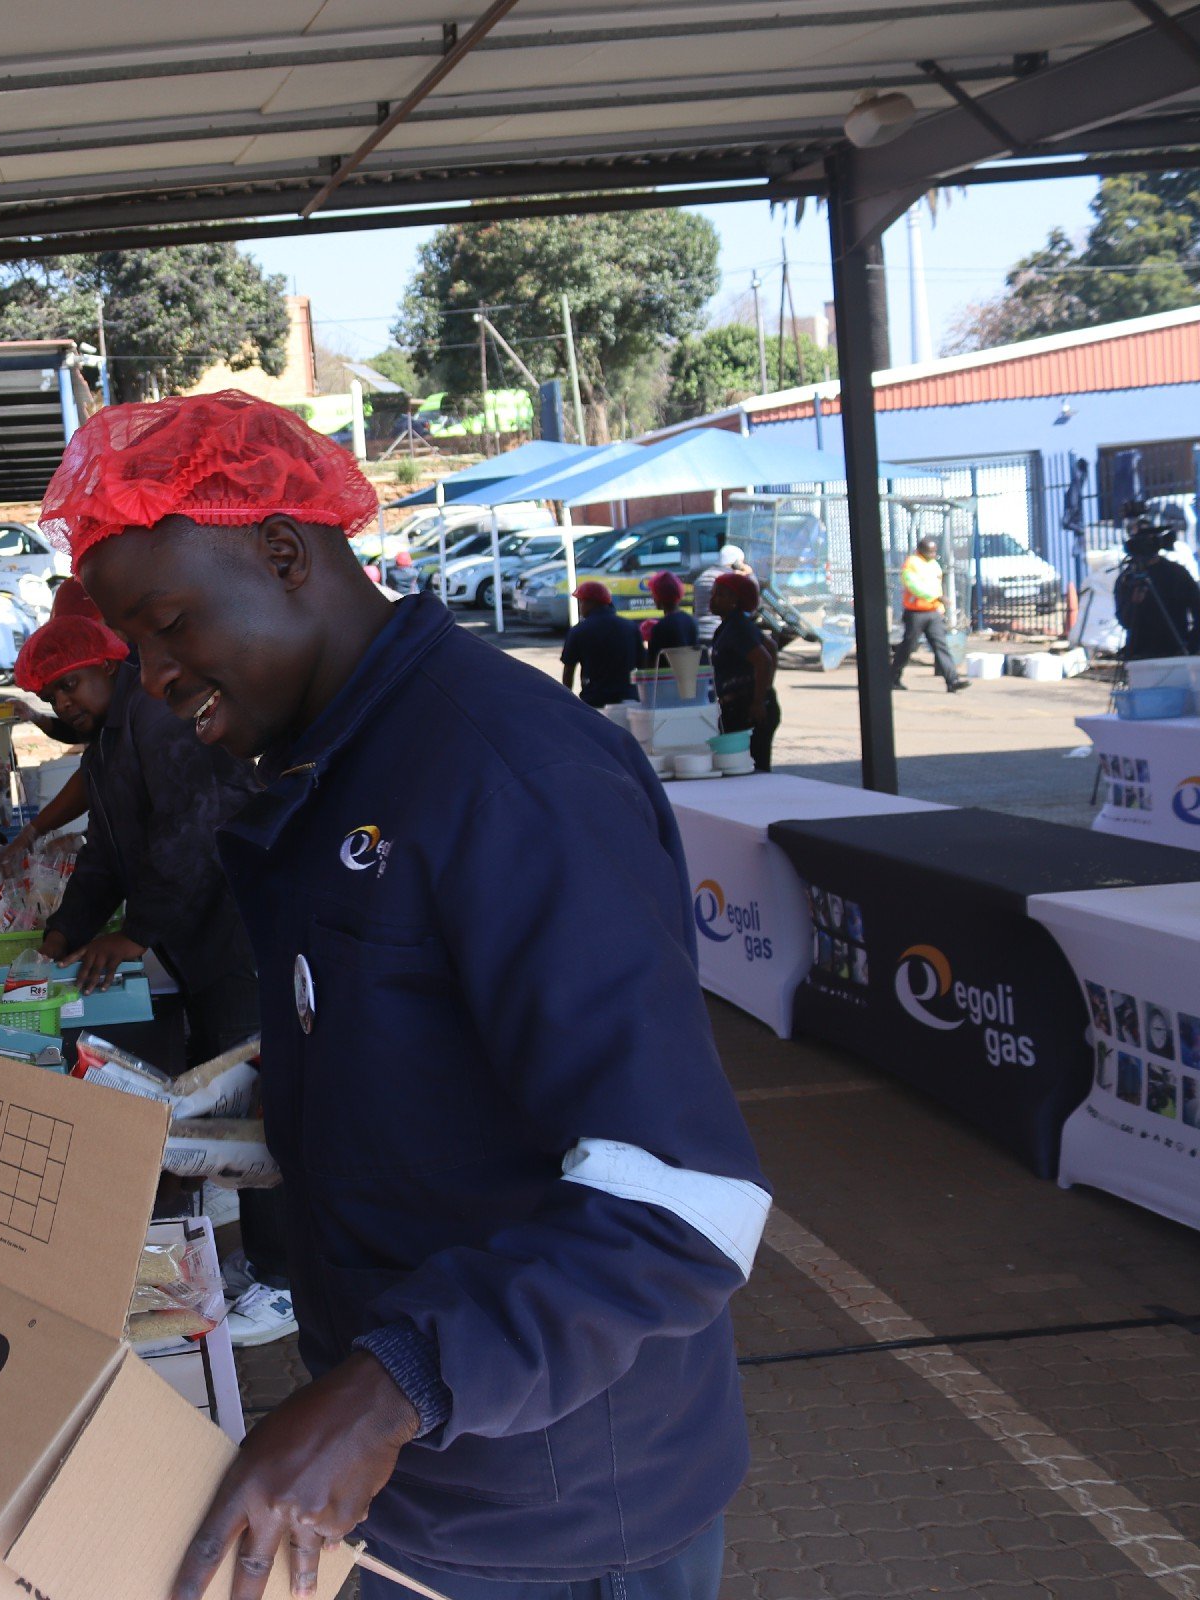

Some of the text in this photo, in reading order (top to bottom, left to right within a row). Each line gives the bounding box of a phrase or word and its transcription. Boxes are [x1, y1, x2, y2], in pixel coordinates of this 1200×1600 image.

[727, 901, 760, 934] egoli
[744, 935, 773, 962] gas
[954, 981, 1014, 1026] egoli
[985, 1027, 1036, 1067] gas
